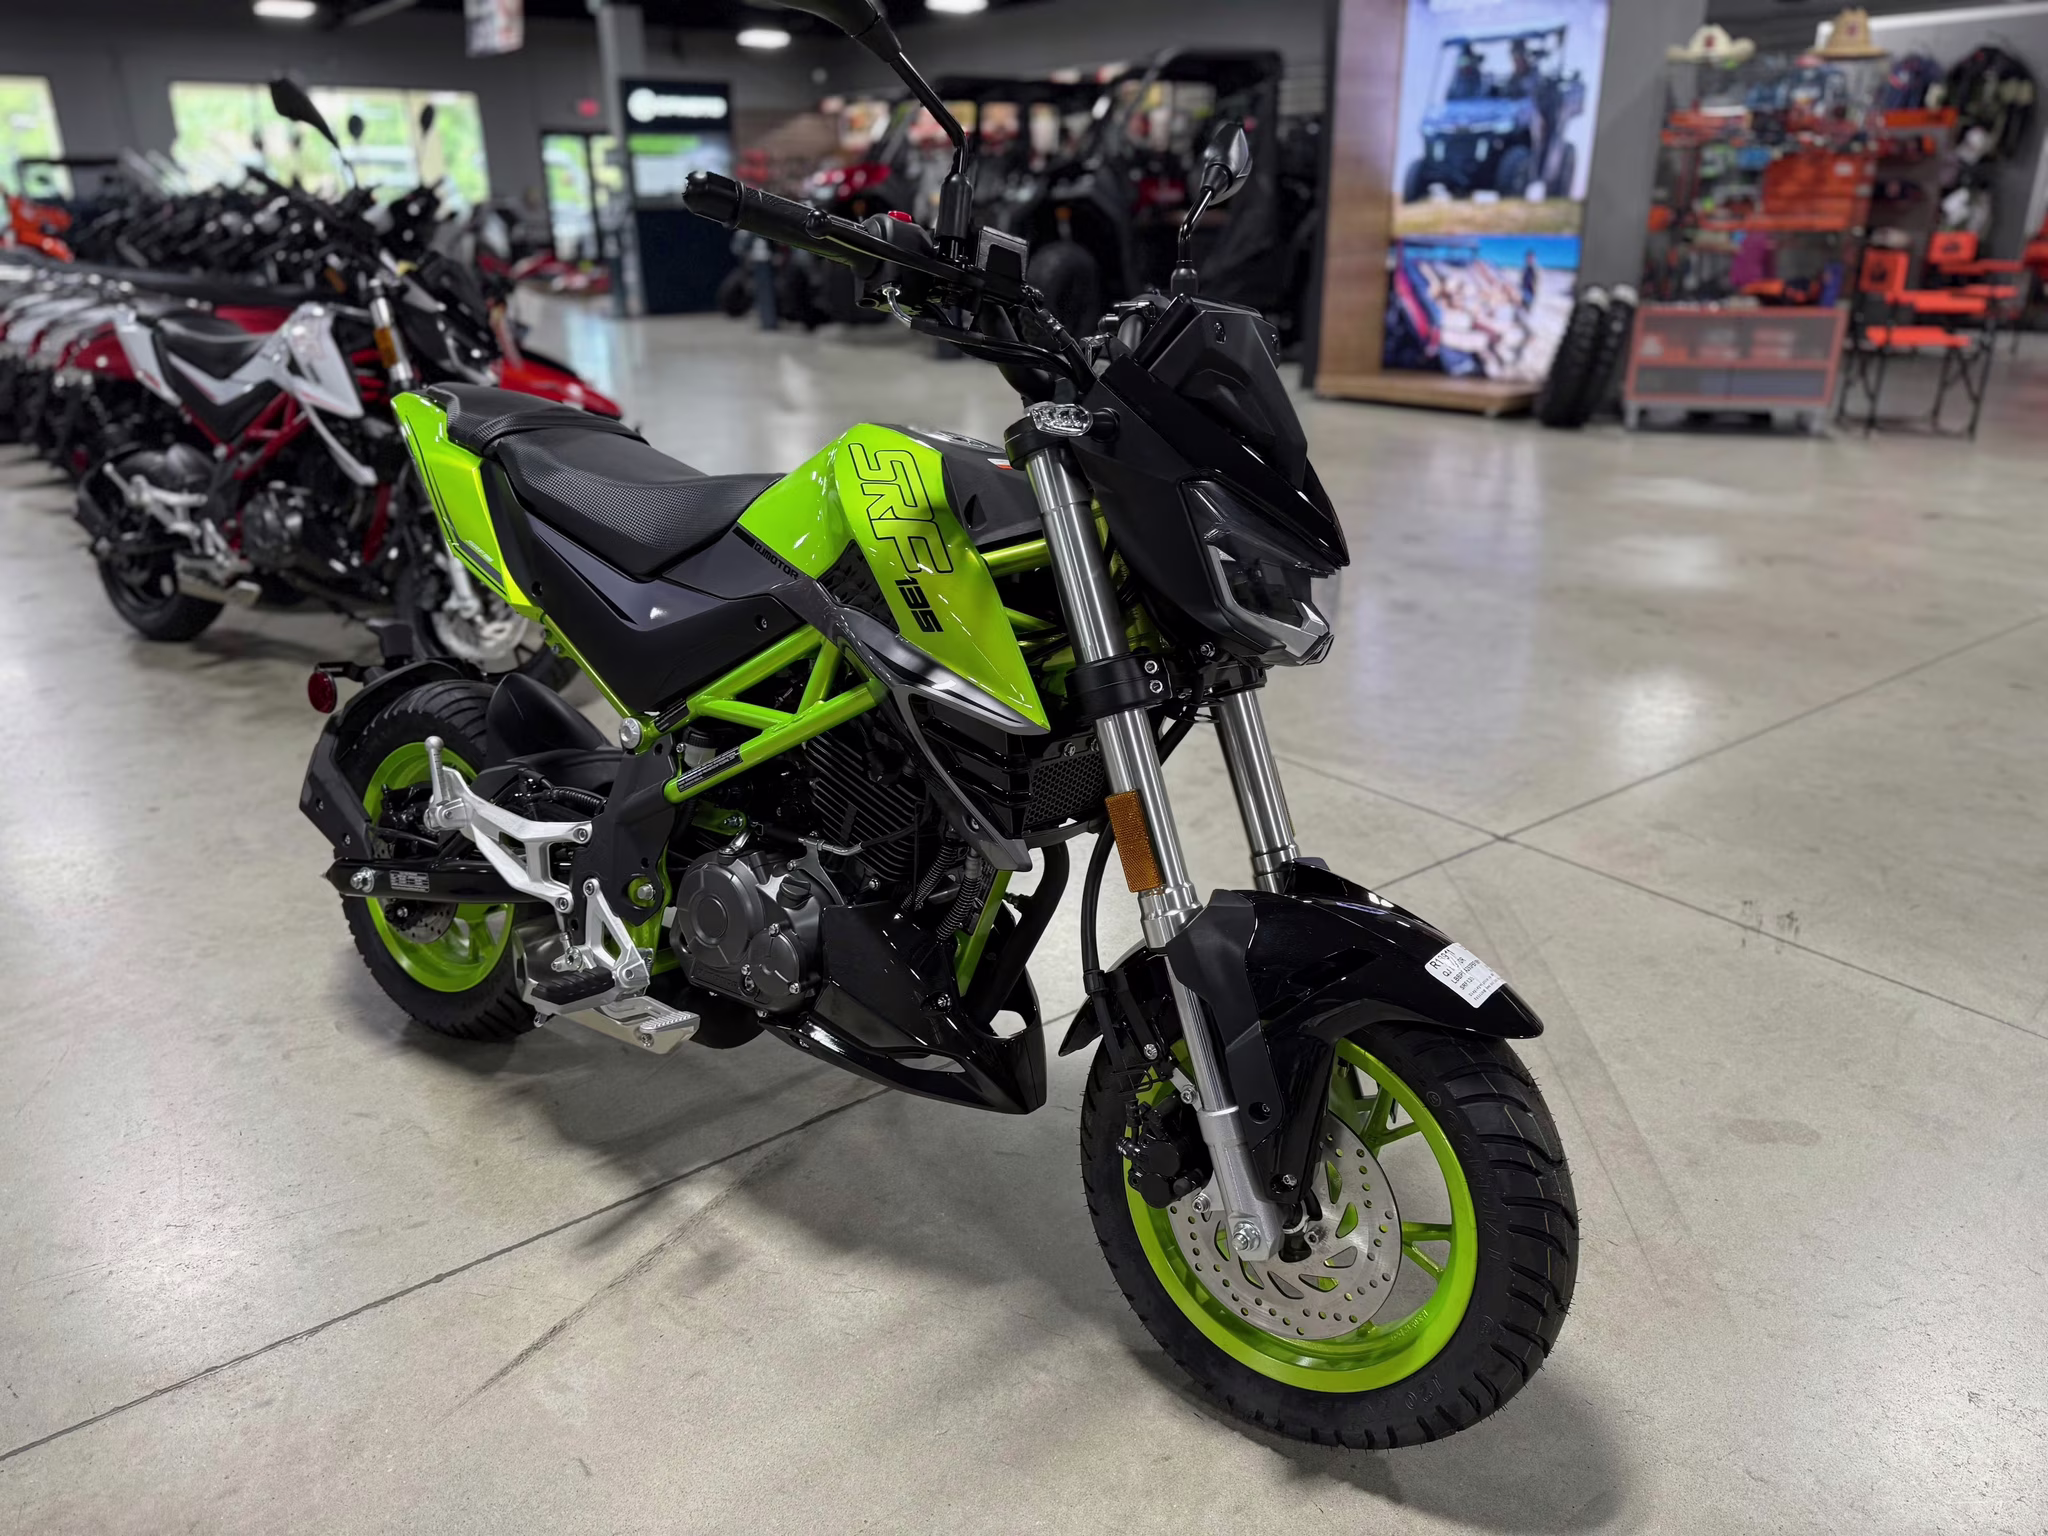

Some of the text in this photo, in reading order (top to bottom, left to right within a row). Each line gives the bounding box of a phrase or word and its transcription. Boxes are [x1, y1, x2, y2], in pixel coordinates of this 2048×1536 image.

[848, 442, 954, 574] SRF
[753, 541, 799, 580] QJMOTOR
[894, 576, 944, 633] 135
